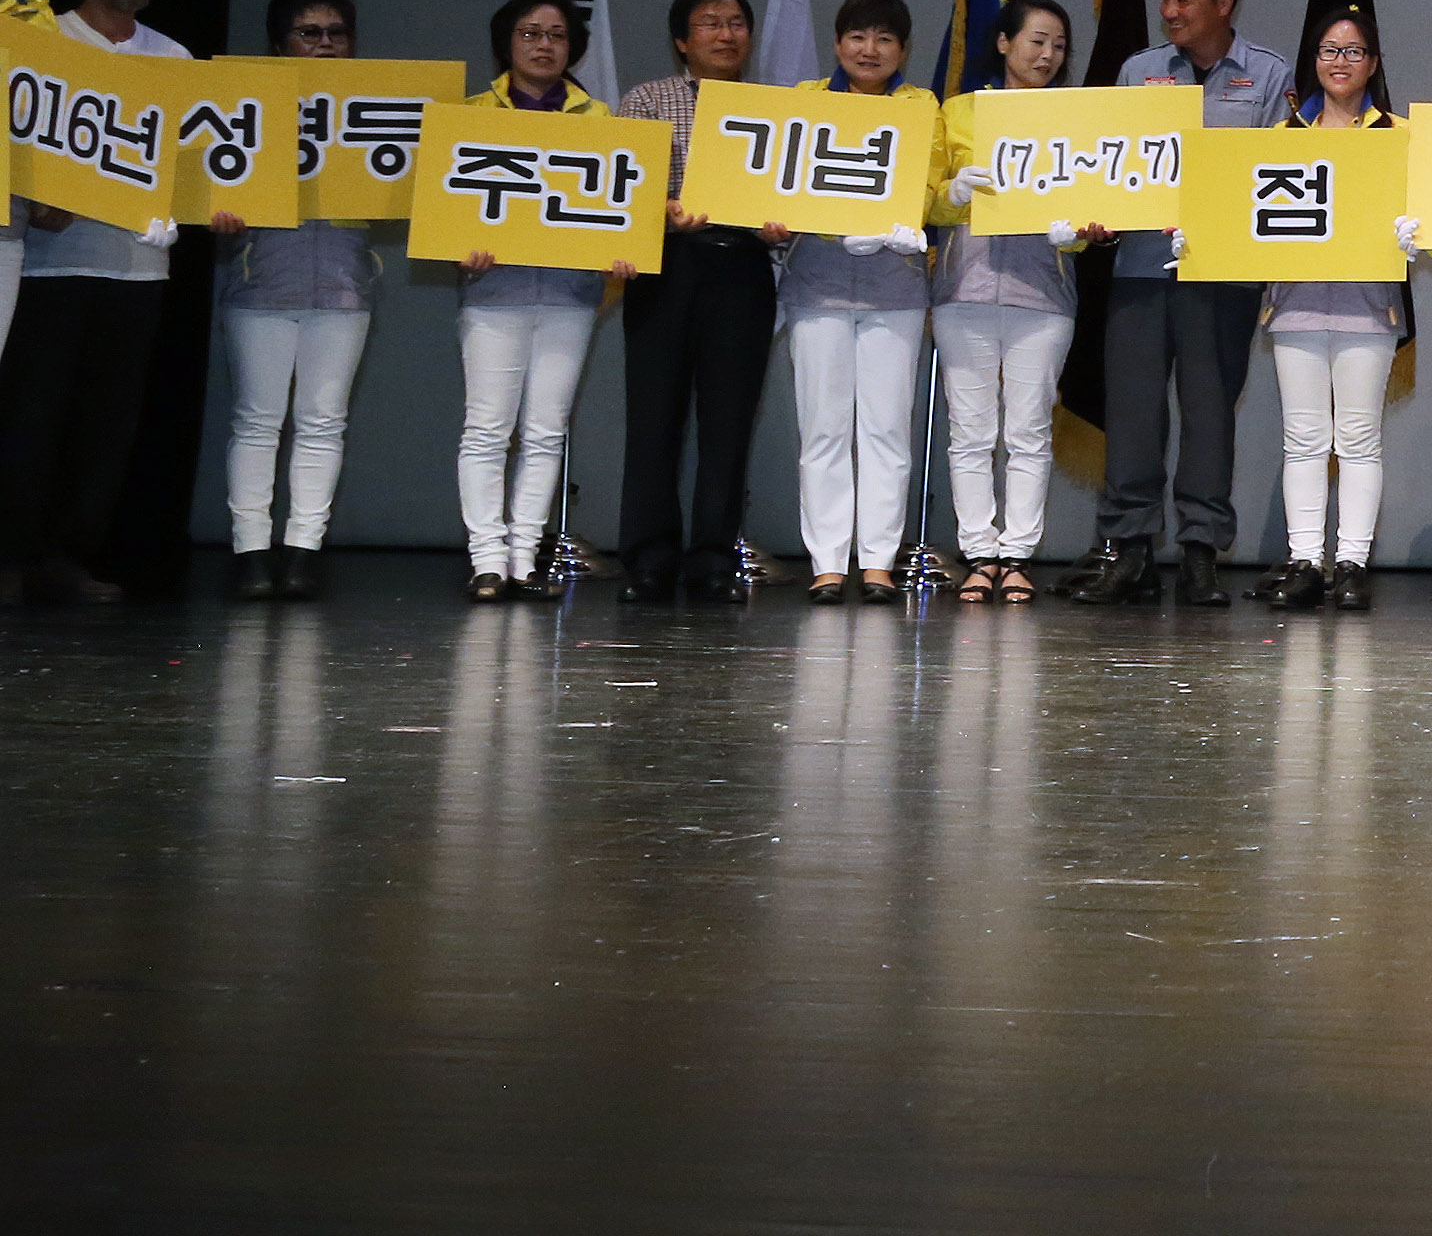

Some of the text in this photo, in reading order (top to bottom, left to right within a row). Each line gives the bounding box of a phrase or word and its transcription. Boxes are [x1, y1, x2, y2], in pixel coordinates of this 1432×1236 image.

[178, 103, 256, 181] 성
[724, 120, 893, 196] 기념
[997, 137, 1180, 190] (7.1~7.7)
[448, 146, 639, 227] 주간
[1256, 164, 1328, 237] 점
